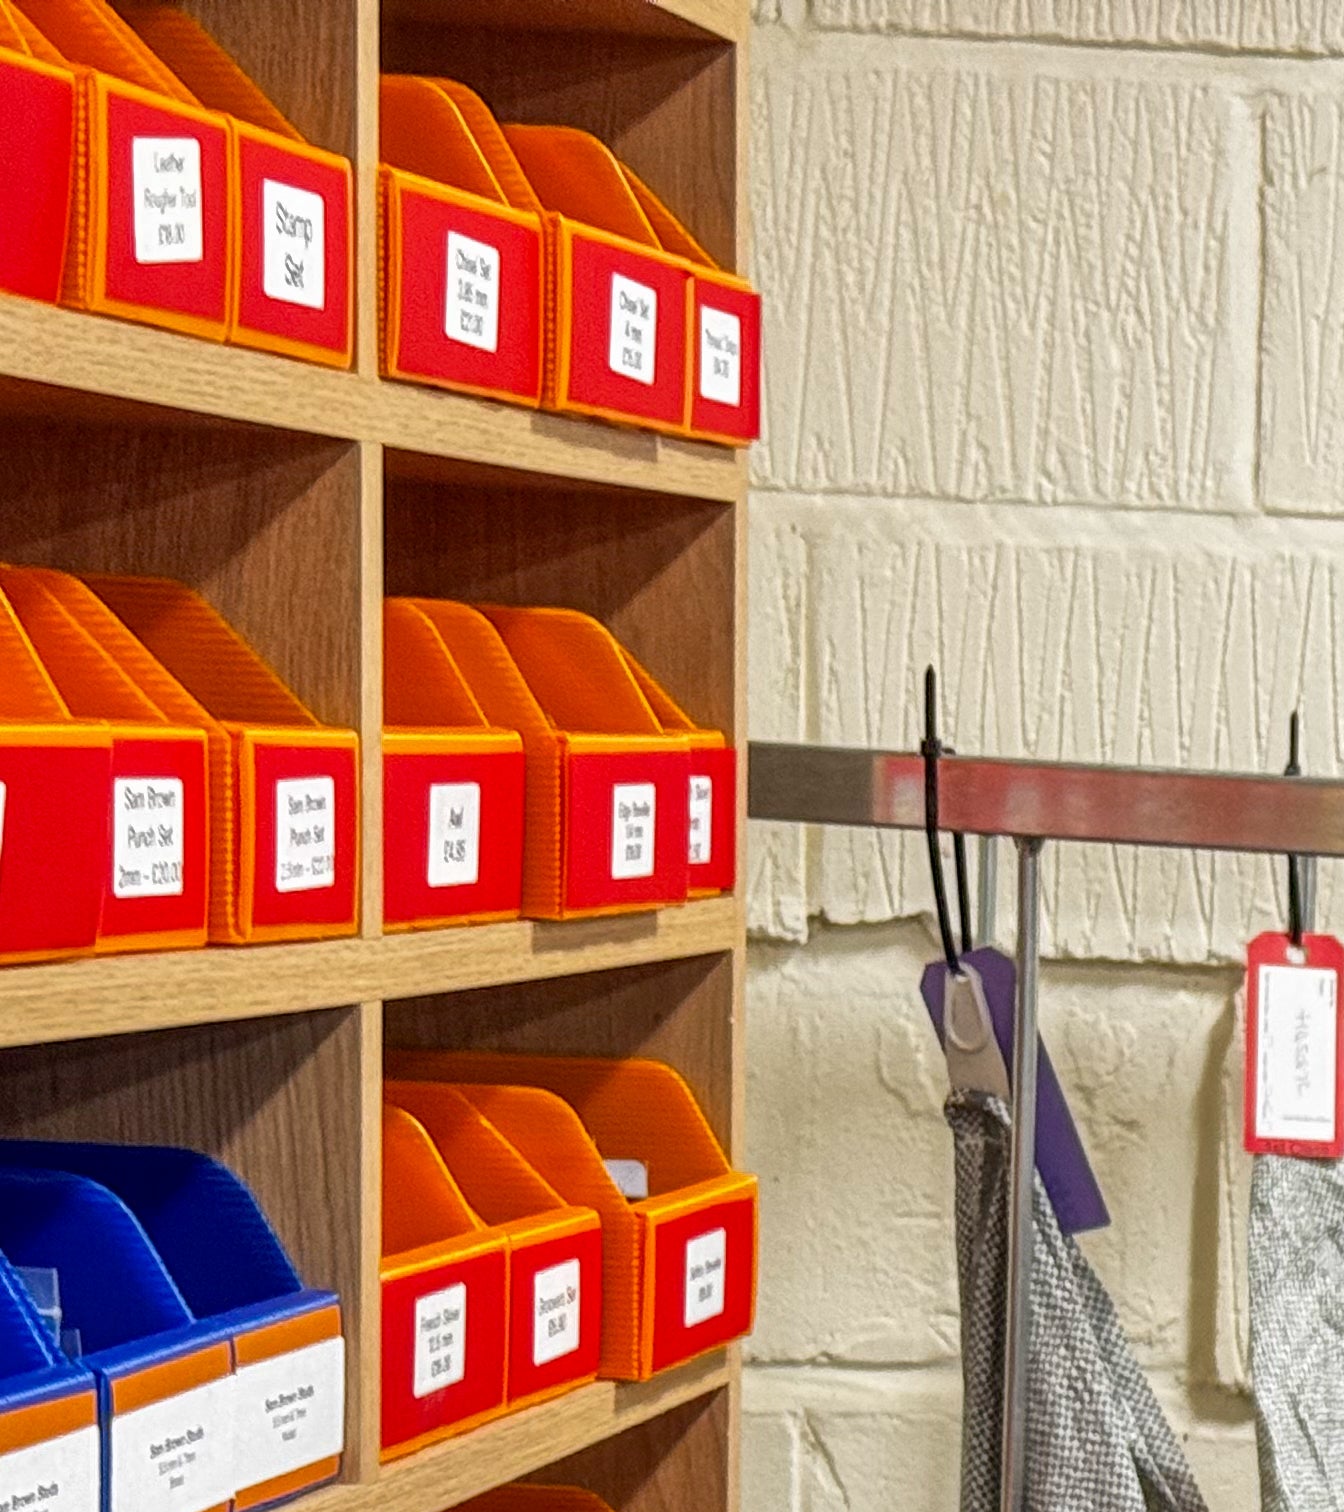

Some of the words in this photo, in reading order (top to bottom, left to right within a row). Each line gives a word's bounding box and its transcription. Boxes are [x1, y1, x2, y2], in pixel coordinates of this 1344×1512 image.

[154, 151, 185, 173] Leather
[276, 200, 313, 249] Stamp
[284, 251, 305, 289] Set
[124, 786, 145, 811] Sam
[147, 785, 176, 811] Brown
[288, 794, 304, 816] Sam
[305, 792, 327, 814] Brown
[127, 824, 155, 850] Punch
[158, 823, 174, 849] Set
[289, 826, 312, 848] Punch
[313, 824, 326, 845] Set
[0, 1490, 12, 1512] am
[12, 1486, 36, 1510] Brown
[37, 1479, 59, 1501] Studs
